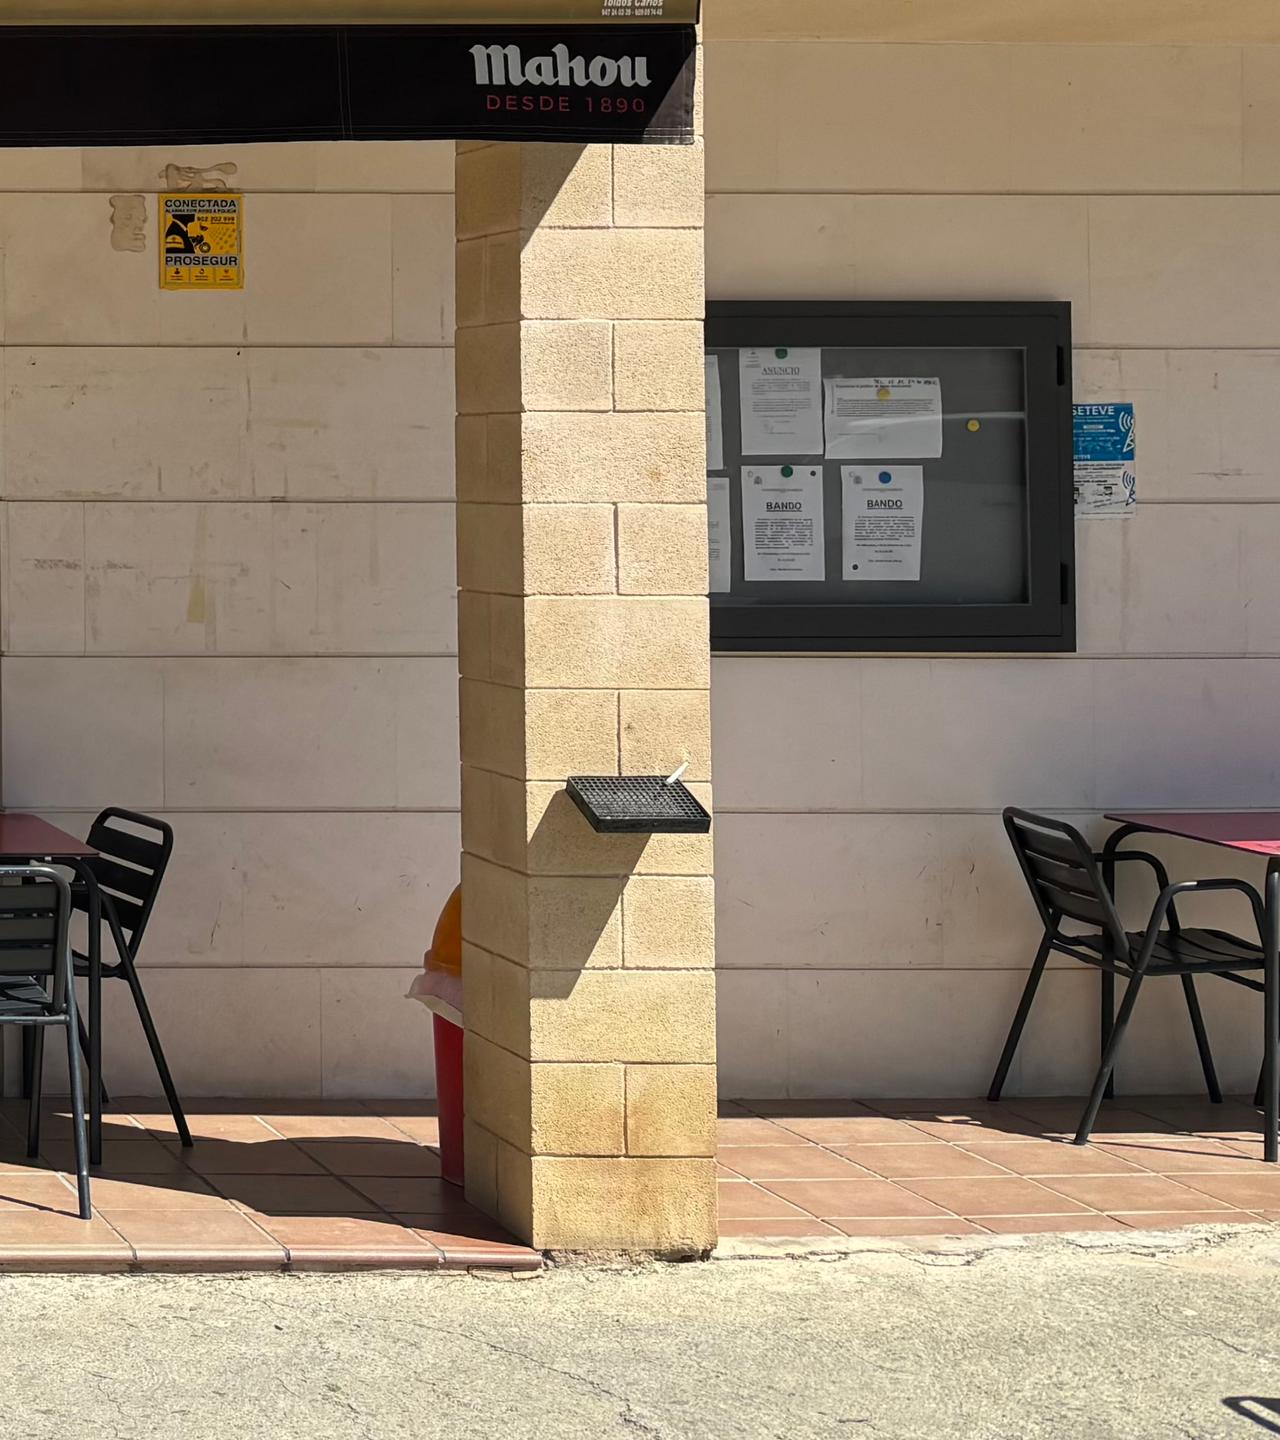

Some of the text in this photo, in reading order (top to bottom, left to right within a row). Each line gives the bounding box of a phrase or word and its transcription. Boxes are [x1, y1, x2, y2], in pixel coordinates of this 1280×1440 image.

[469, 43, 652, 87] Mahou
[487, 95, 645, 113] DESDE 1890
[165, 199, 236, 208] CONECTADA
[165, 256, 238, 266] PROSEGUR
[766, 502, 802, 510] BANDO
[866, 499, 903, 508] BANDO
